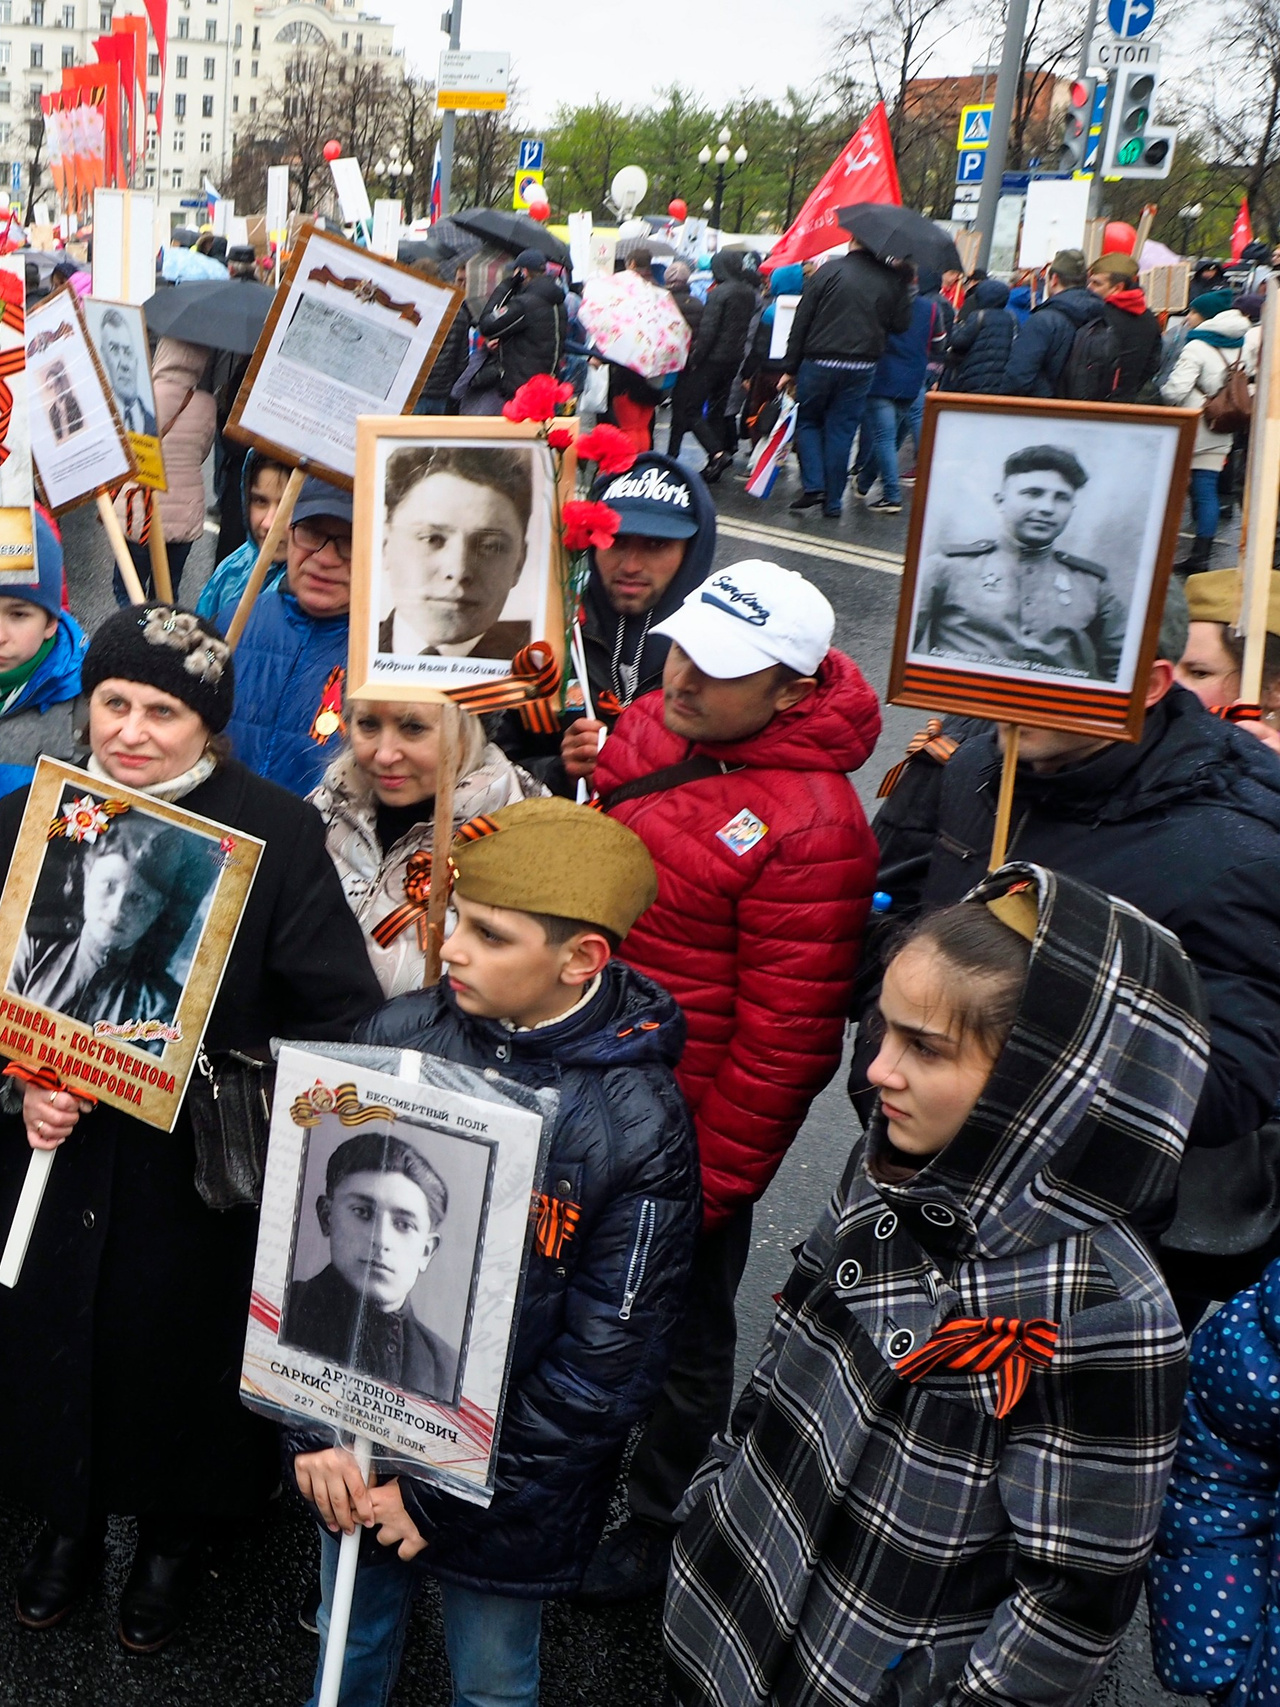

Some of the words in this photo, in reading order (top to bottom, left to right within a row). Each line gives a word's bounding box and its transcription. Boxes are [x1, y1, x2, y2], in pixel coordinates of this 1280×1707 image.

[1099, 45, 1150, 64] СТОП
[963, 153, 982, 179] P
[418, 662, 447, 673] Иван
[0, 1026, 35, 1056] АННА
[37, 1043, 143, 1106] ВЛАДИМИРОВНА
[70, 1031, 176, 1094] КОСТЮЧЕНКОВА
[366, 1090, 450, 1121] БЕССМЕРТНЫЙ
[456, 1116, 489, 1132] ПОЛК
[270, 1361, 331, 1393] САРКИС
[340, 1388, 459, 1444] КАРАПЕТОВИЧ
[321, 1366, 406, 1408] АРУТЮНОВ
[294, 1394, 315, 1408] 227
[320, 1404, 392, 1438] СТРЕЛКОВОЙ
[397, 1435, 427, 1453] ПОЛК
[335, 1400, 386, 1425] СЕРЖАНТ
